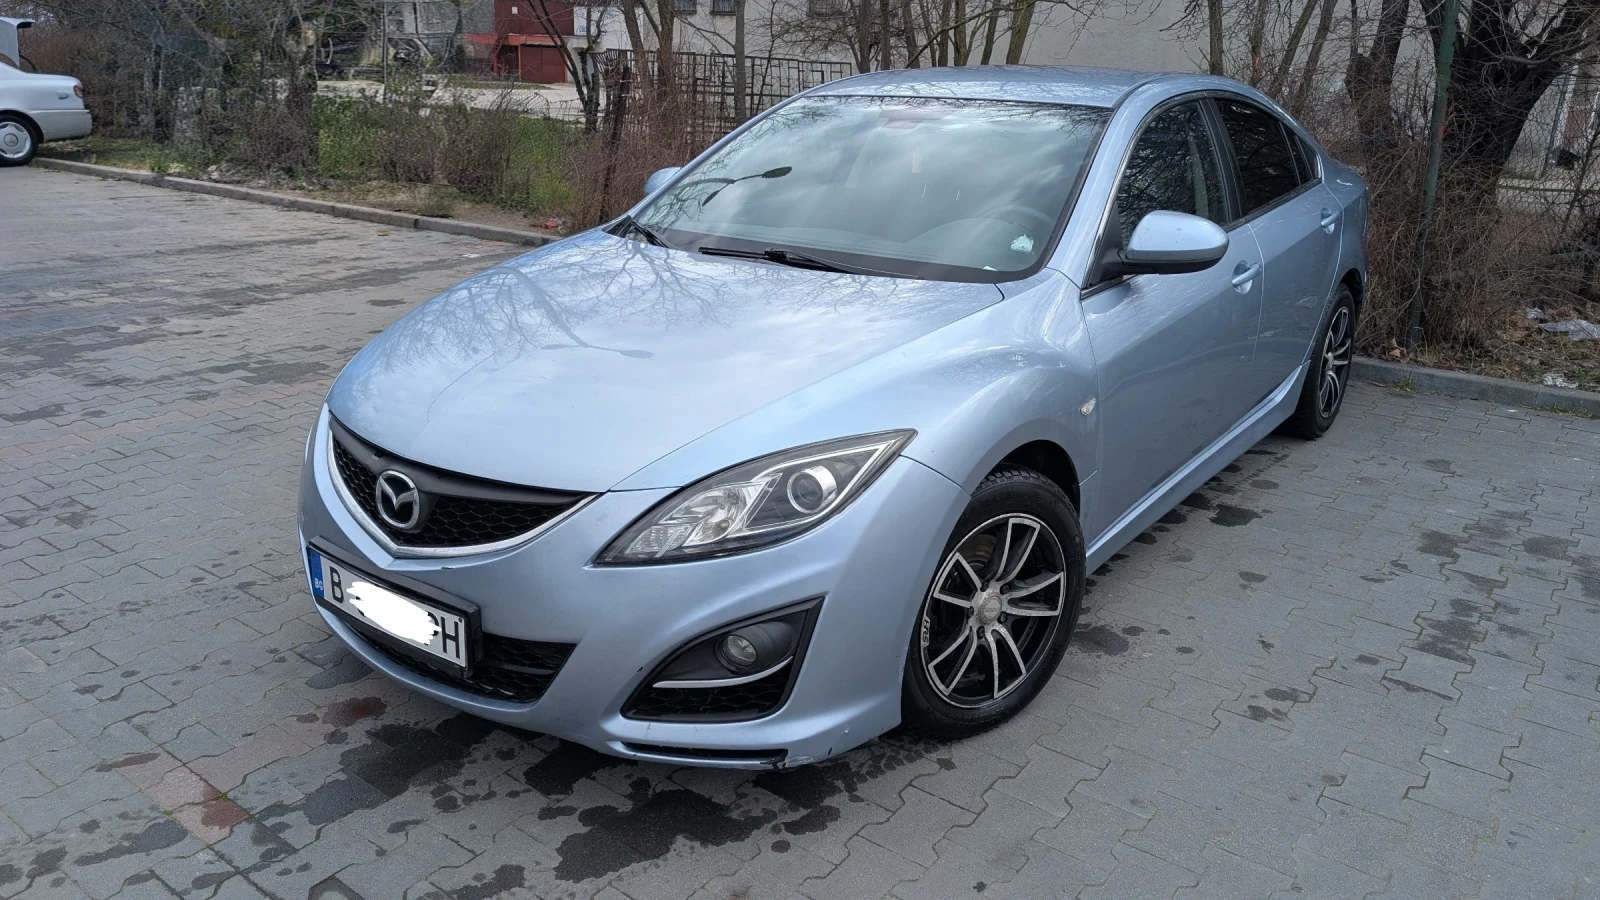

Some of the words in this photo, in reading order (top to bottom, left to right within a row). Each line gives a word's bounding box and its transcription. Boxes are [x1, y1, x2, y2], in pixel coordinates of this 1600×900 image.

[315, 578, 323, 591] BG
[329, 565, 344, 603] B
[922, 619, 930, 644] HRS
